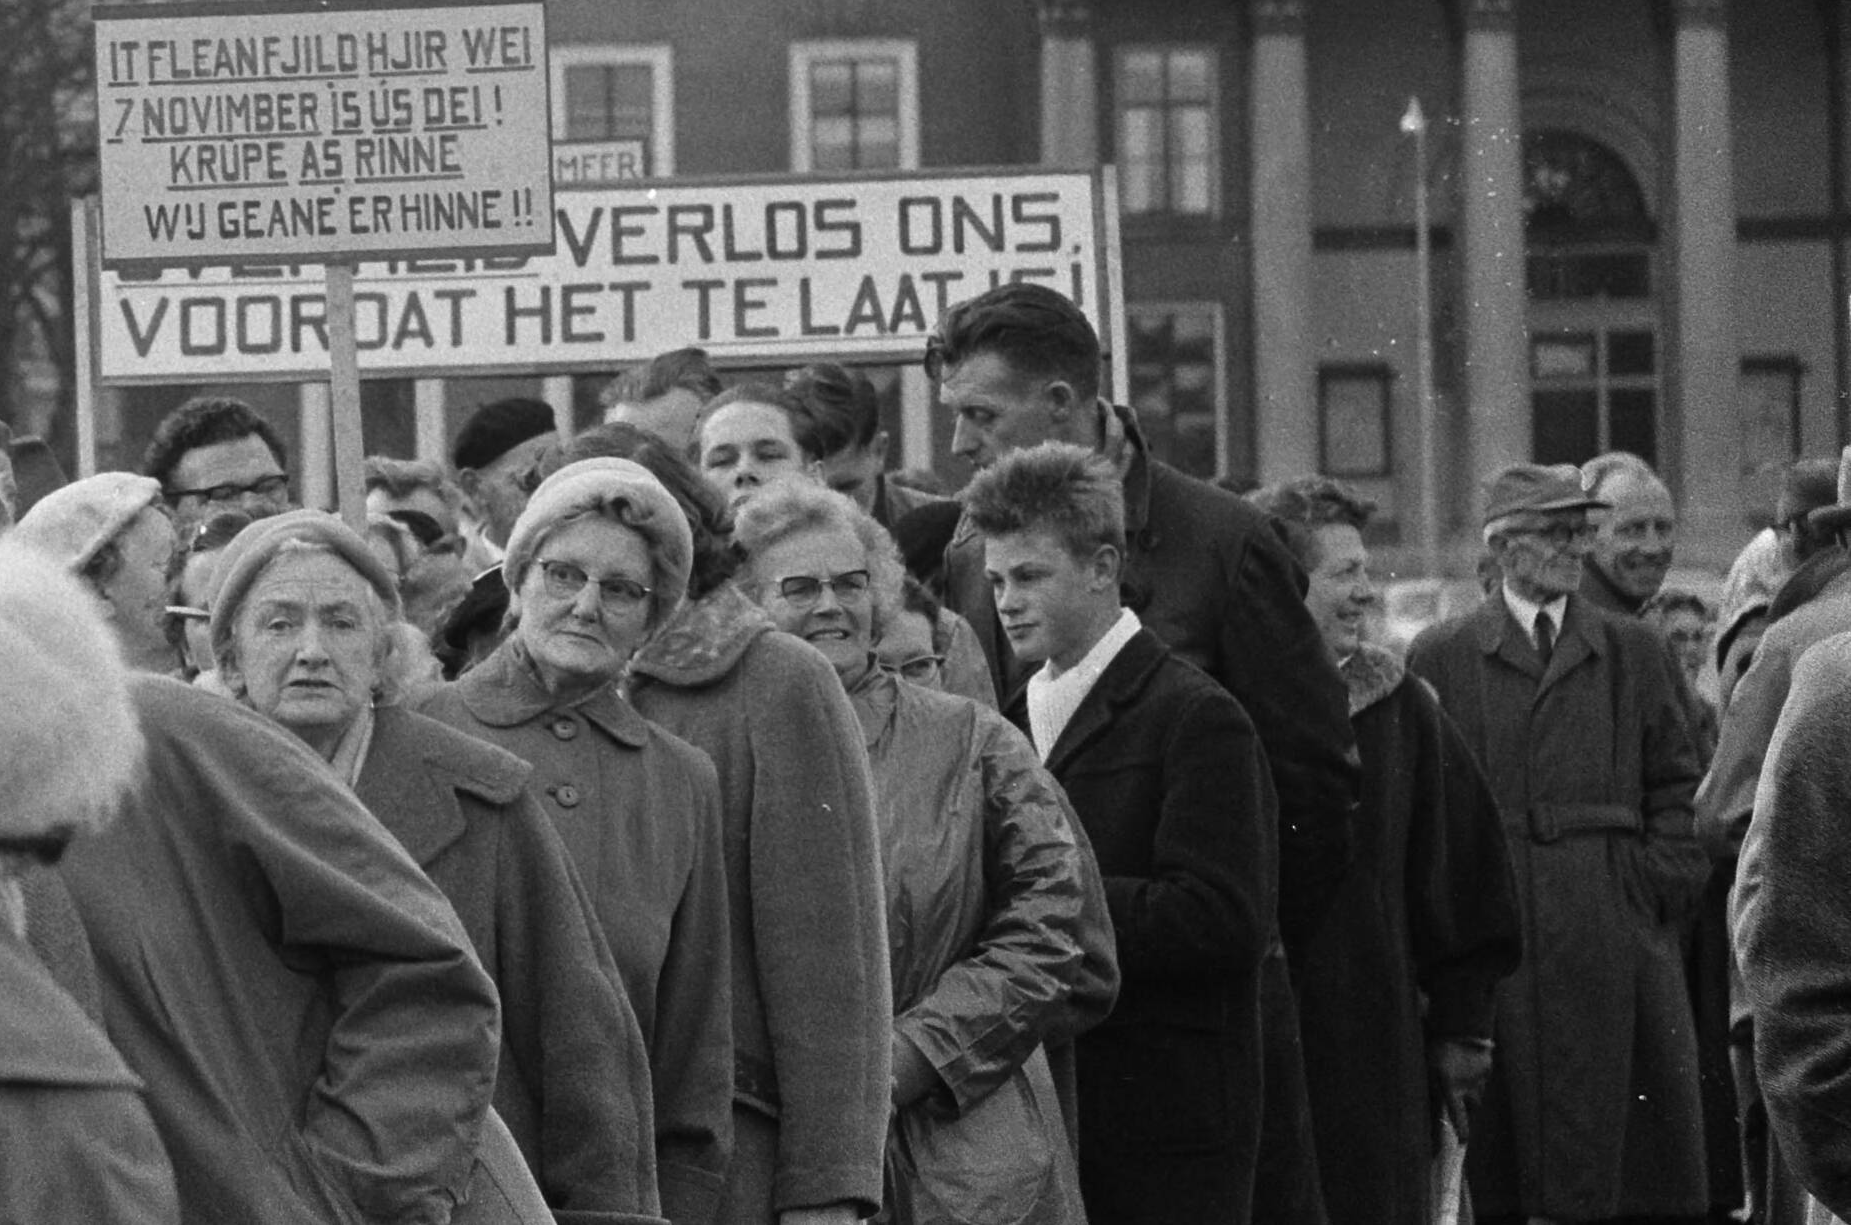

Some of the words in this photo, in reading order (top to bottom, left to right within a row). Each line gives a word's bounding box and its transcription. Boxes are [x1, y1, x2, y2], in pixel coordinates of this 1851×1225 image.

[110, 41, 140, 82] IT
[148, 33, 358, 79] FLEANFJILD
[367, 30, 447, 71] HJIR
[462, 26, 532, 66] WEI
[115, 98, 135, 137] 7
[143, 92, 319, 136] NOVIMBER
[300, 139, 343, 178] AS
[354, 134, 462, 176] RINNE
[217, 196, 337, 240] GEANE
[349, 195, 392, 234] ER
[556, 199, 863, 268] VERLOS
[505, 280, 651, 345] HET
[682, 278, 779, 340] TE
[799, 270, 964, 336] LAAT
